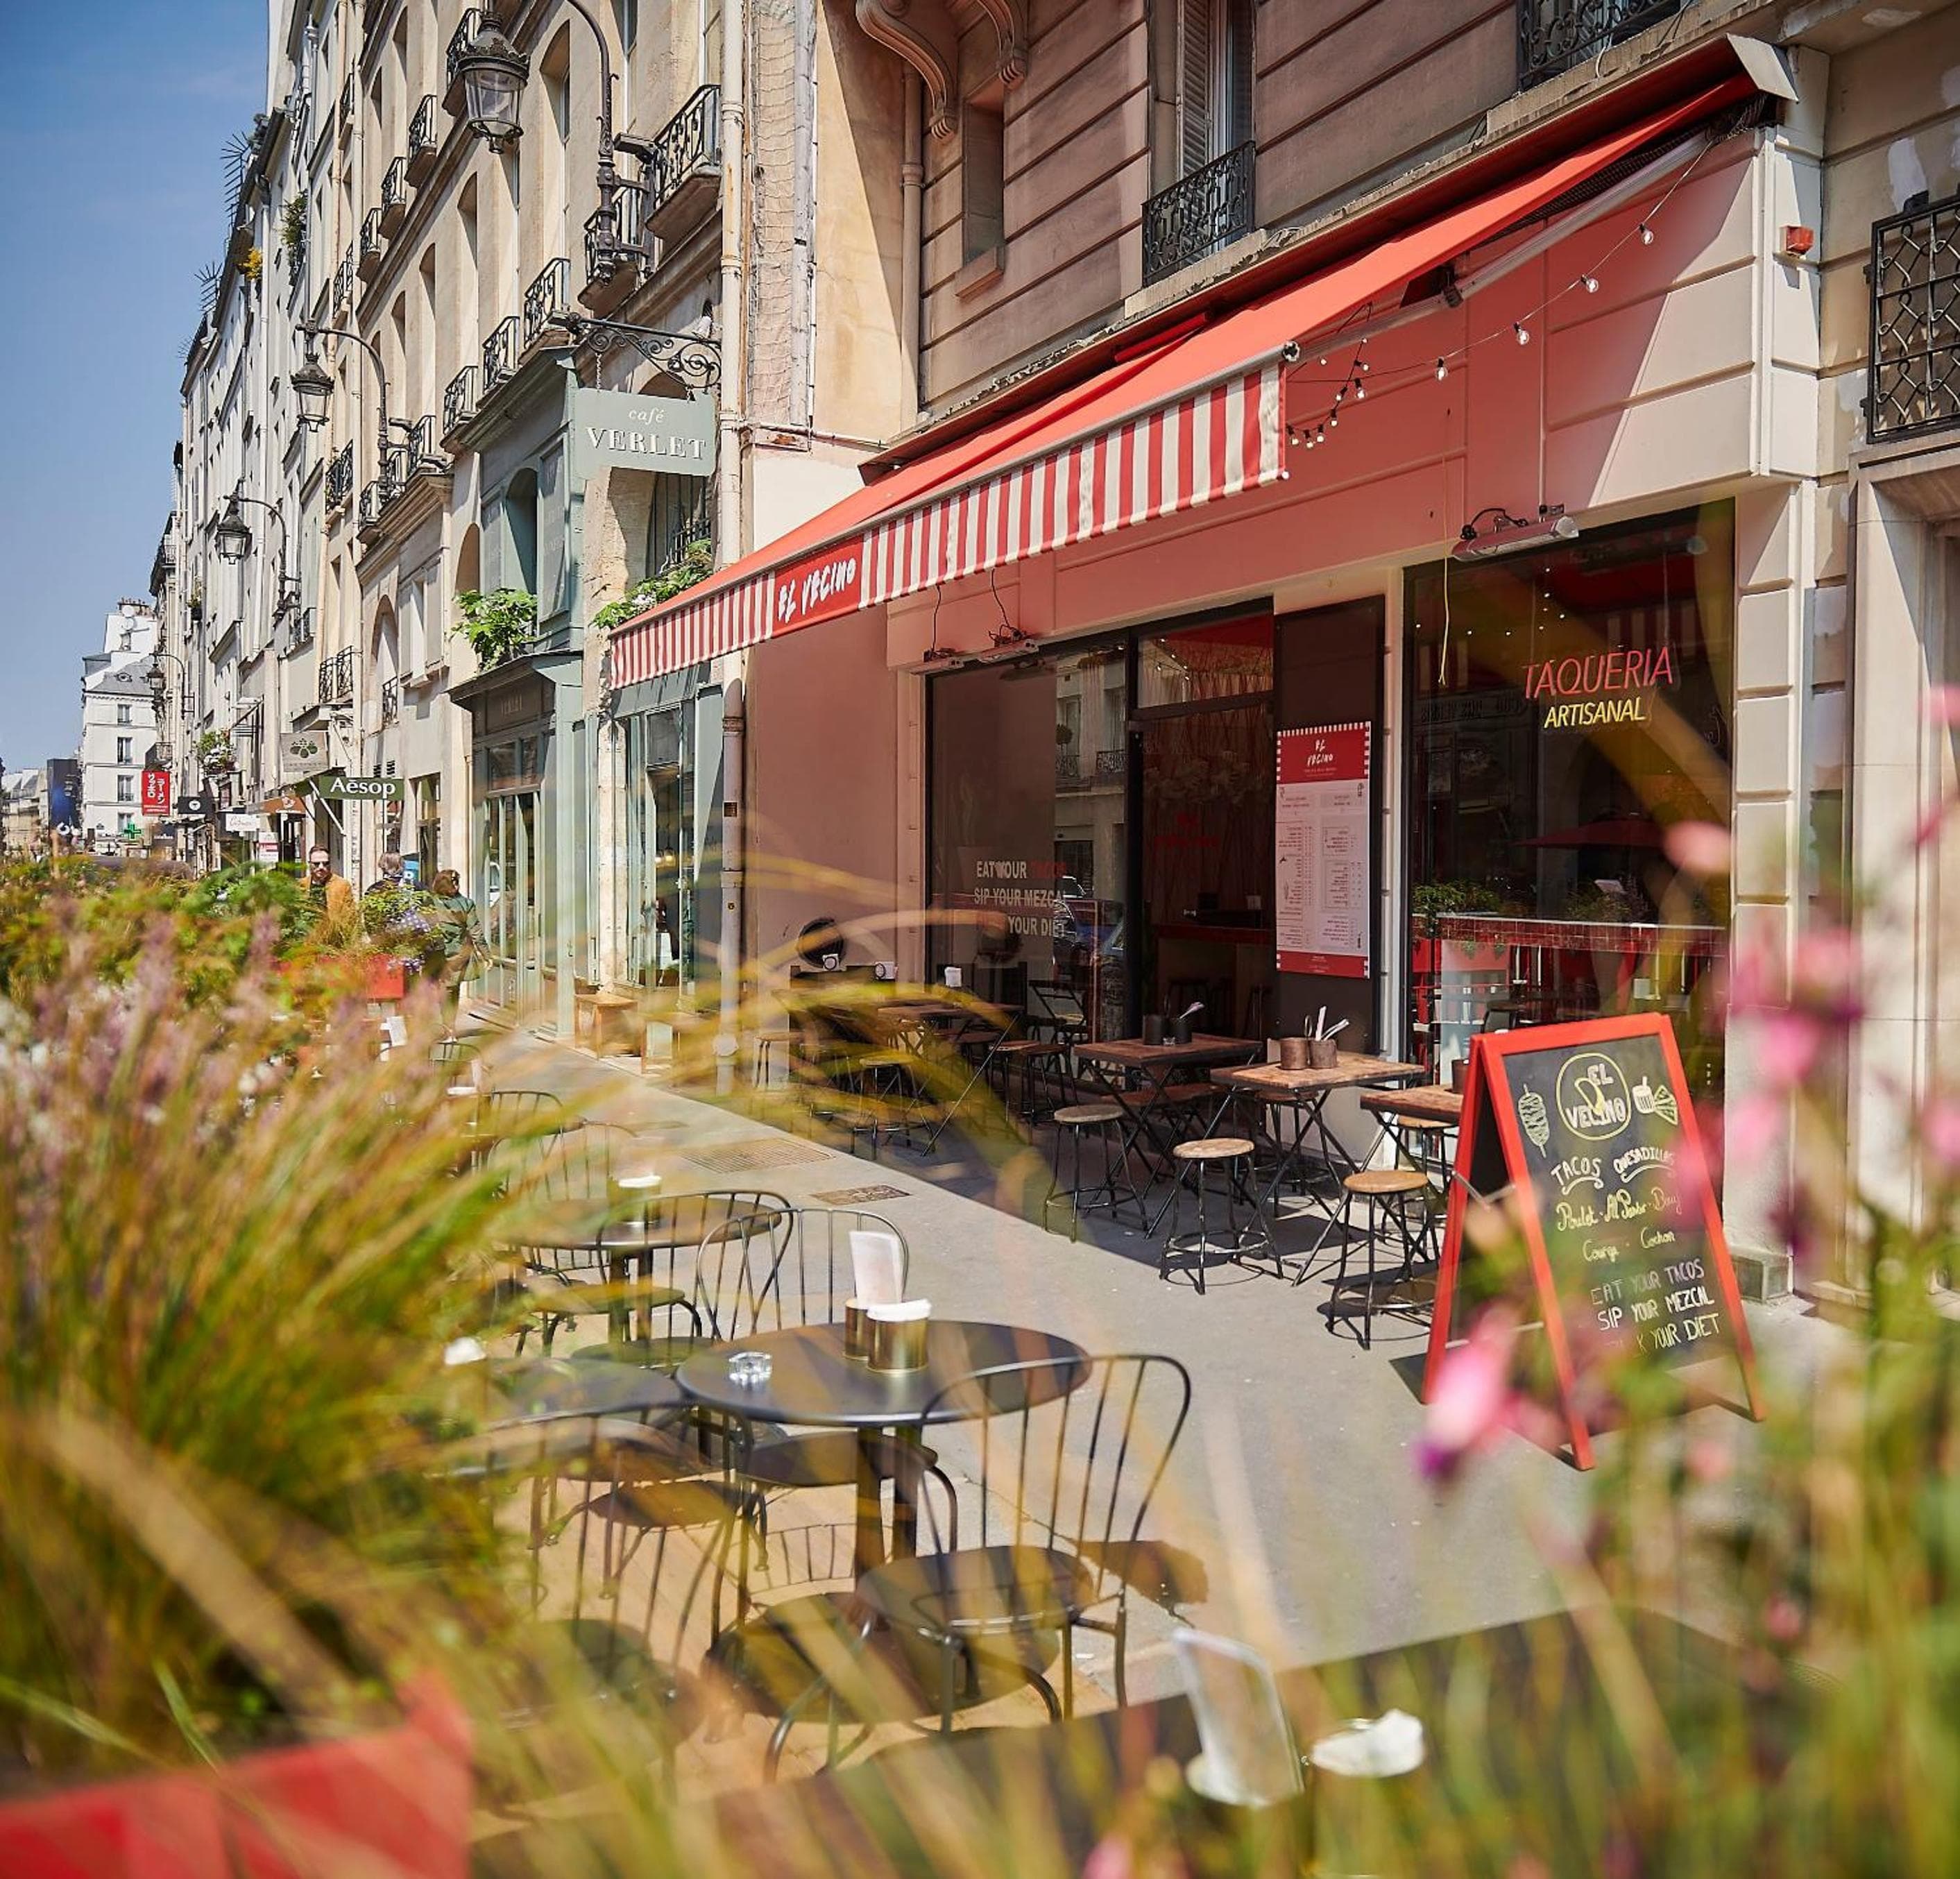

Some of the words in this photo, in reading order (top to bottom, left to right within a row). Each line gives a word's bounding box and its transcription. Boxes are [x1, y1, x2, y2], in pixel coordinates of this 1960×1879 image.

[629, 408, 666, 425] café
[586, 427, 706, 460] VERLET
[778, 579, 796, 624] EL
[801, 557, 856, 615] VECINO
[1521, 646, 1673, 699] TAQUERIA
[1544, 696, 1646, 729] ARTISANAL
[1315, 739, 1326, 752] EL
[976, 860, 995, 878] EAT
[973, 887, 989, 905] SIP
[992, 888, 1021, 906] YOUR
[1007, 916, 1037, 935] YOUR
[1587, 1063, 1614, 1086] EL
[1551, 1156, 1602, 1186] TACOS
[1591, 1278, 1624, 1305] EAT
[1631, 1270, 1662, 1294] YOUR
[1664, 1258, 1705, 1284] TACOS
[1597, 1306, 1623, 1331] SIP
[1631, 1299, 1660, 1323] YOUR
[1664, 1285, 1716, 1313] MEZCAL
[1651, 1323, 1682, 1350] YOUR
[1682, 1312, 1719, 1341] DIET
